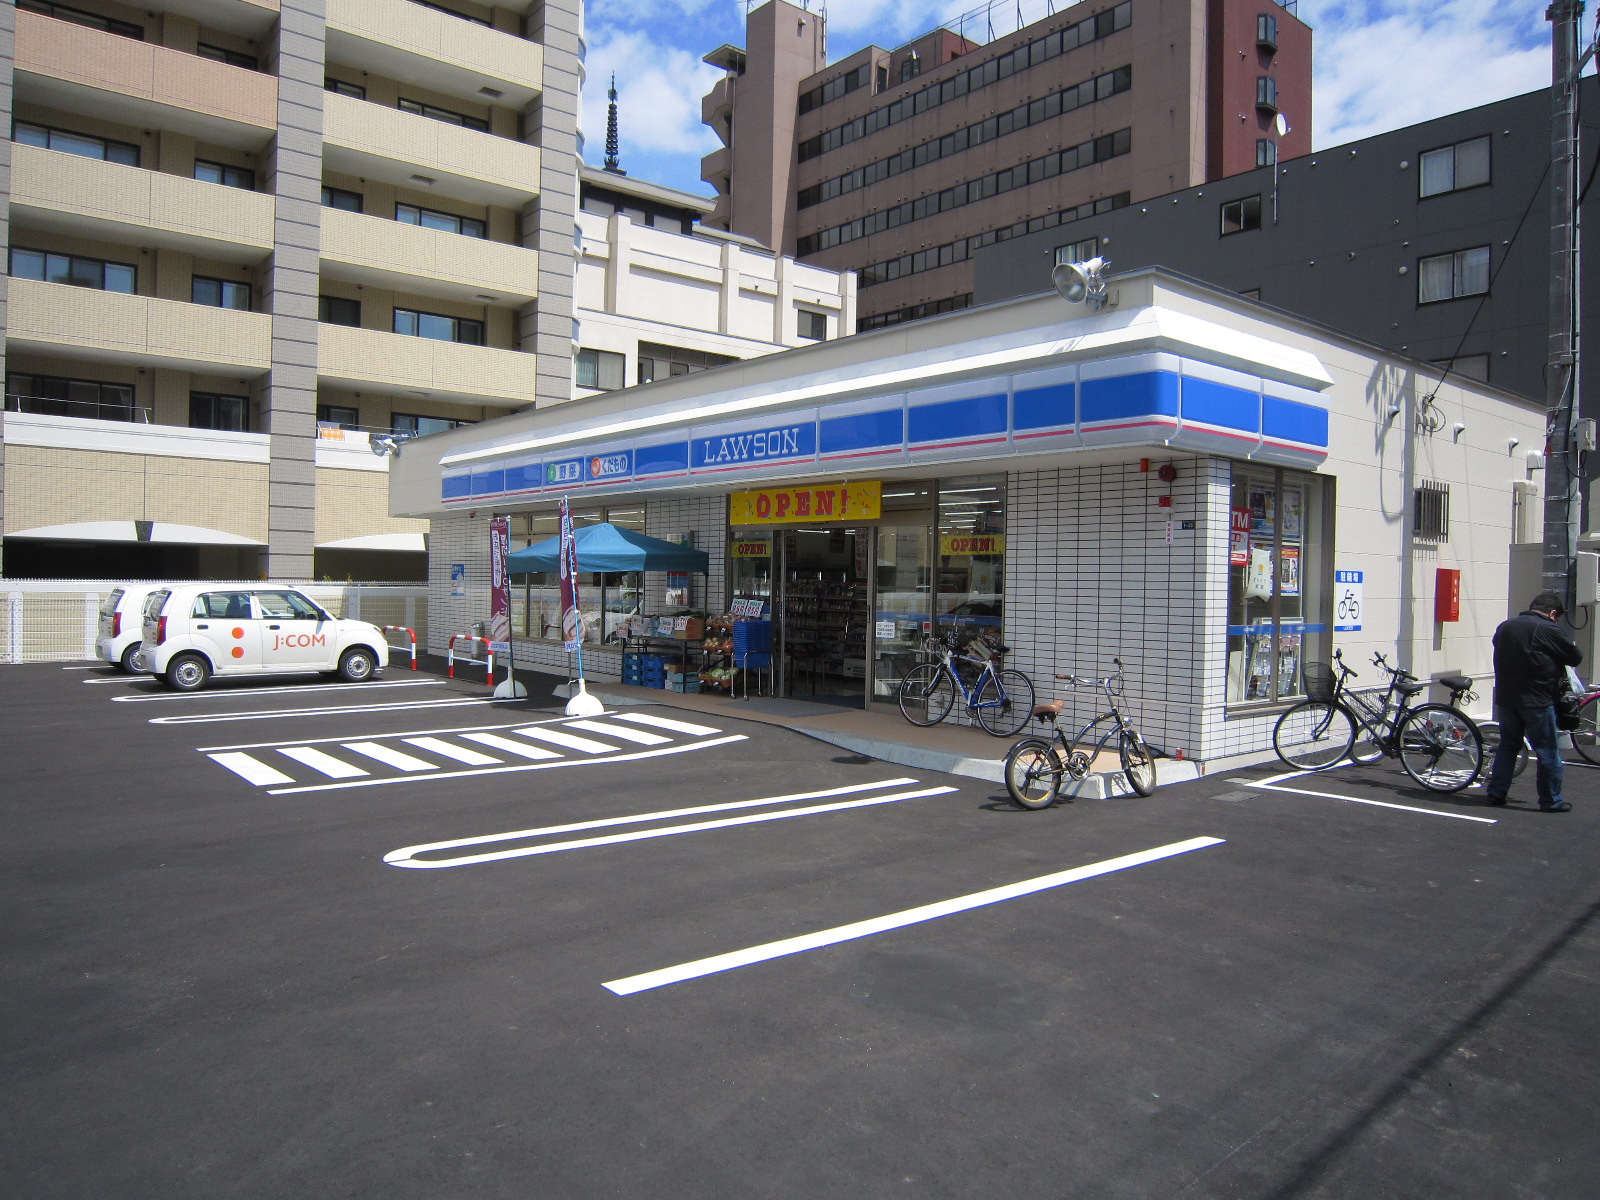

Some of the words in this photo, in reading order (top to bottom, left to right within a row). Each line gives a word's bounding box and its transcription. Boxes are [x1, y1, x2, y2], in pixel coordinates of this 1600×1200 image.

[704, 428, 799, 463] LAWSON
[559, 462, 577, 480] 野菜
[602, 457, 627, 473] くだもの
[756, 489, 848, 518] OPEN!
[738, 543, 767, 555] OPEN!
[951, 538, 995, 553] OPEN!
[272, 634, 326, 651] J:COM
